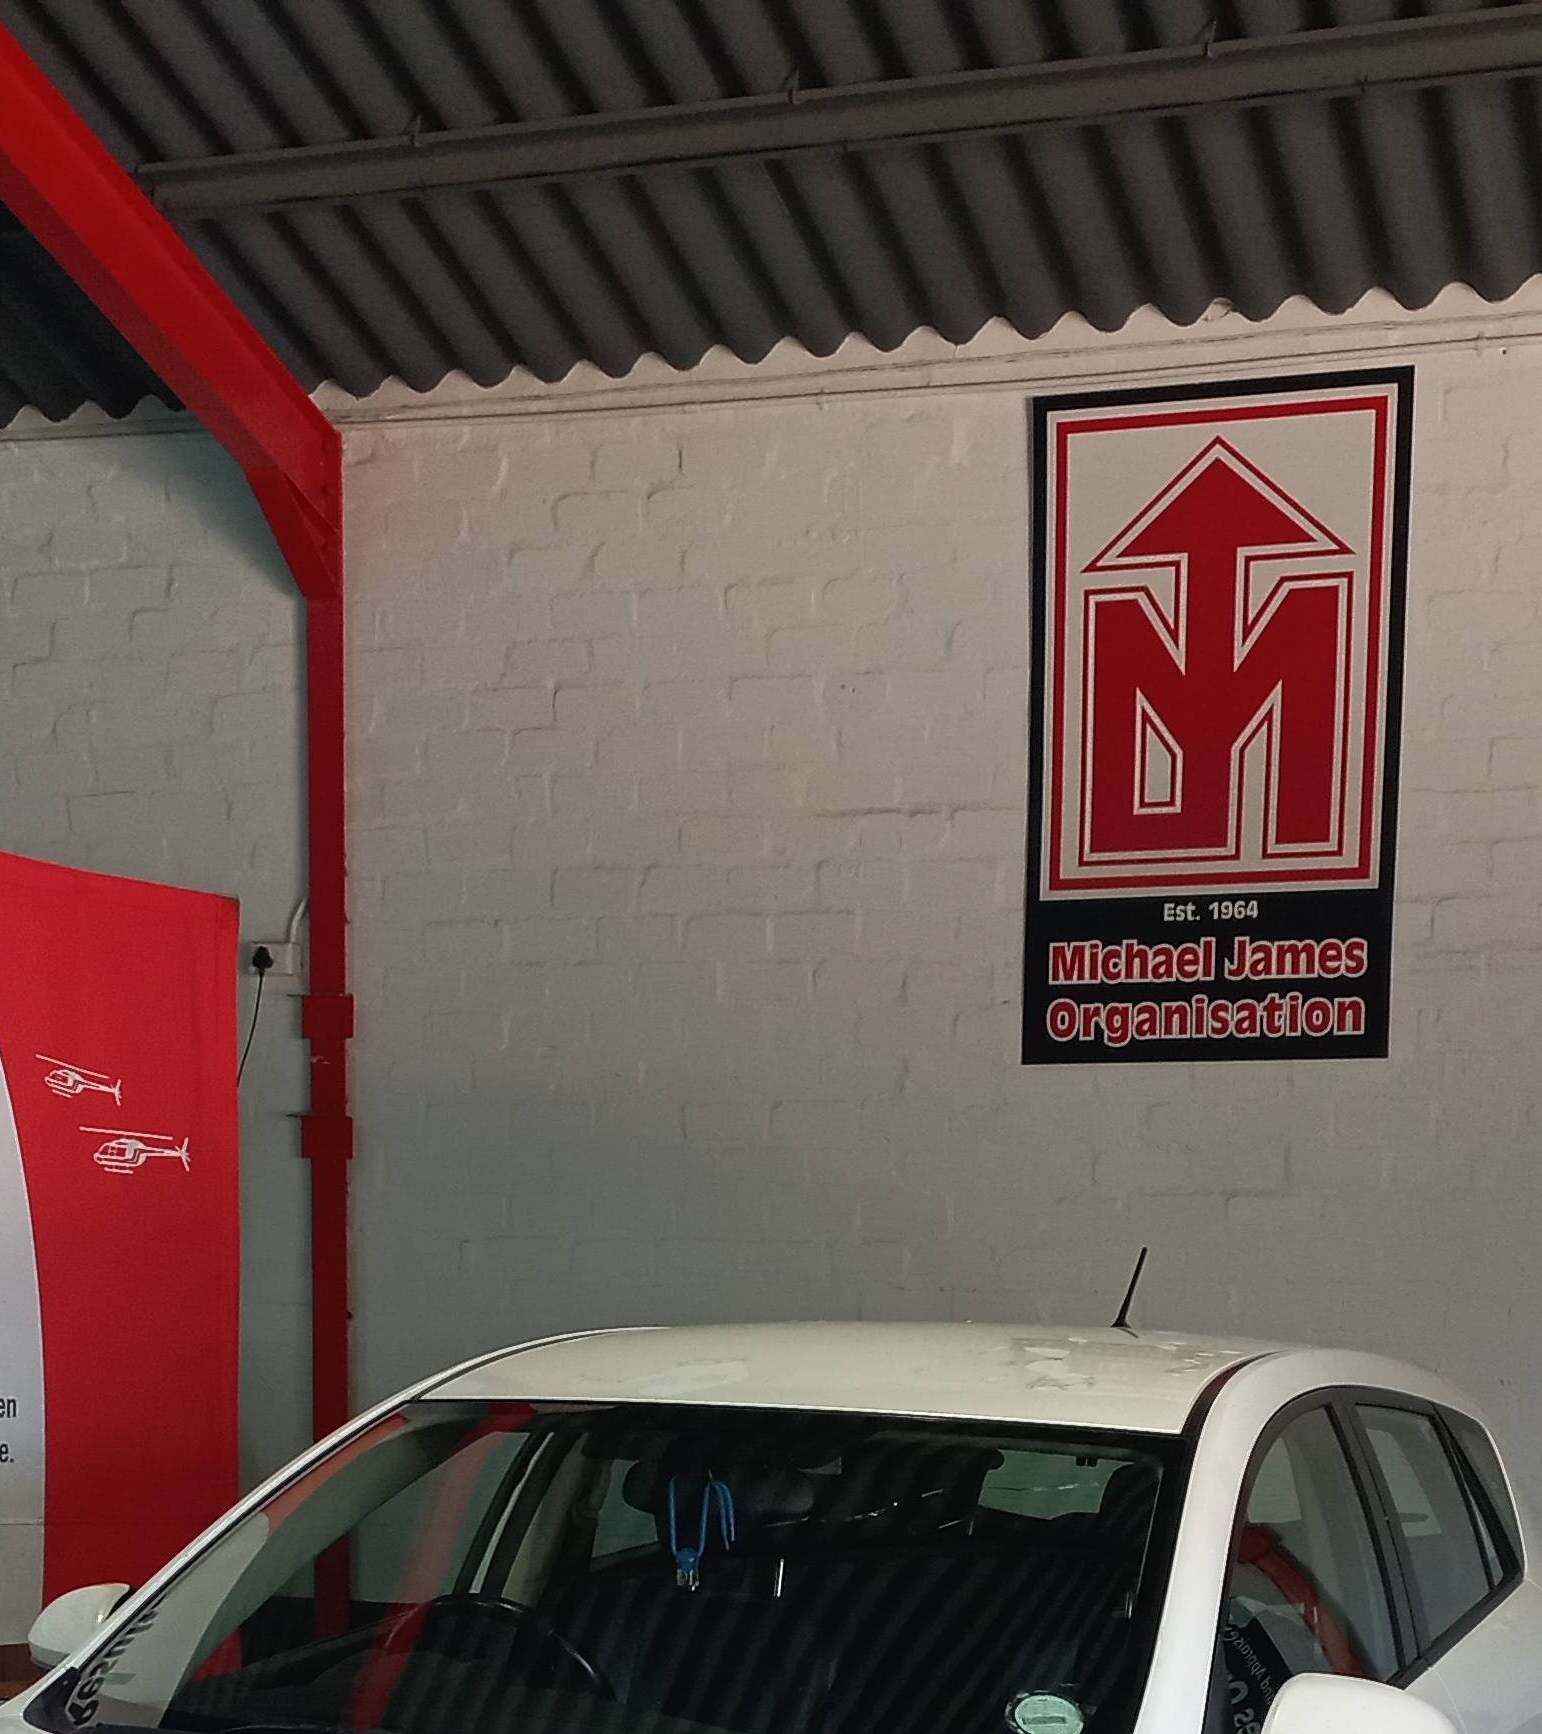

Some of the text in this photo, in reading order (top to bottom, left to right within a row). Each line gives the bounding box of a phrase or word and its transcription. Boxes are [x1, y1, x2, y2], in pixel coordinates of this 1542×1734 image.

[1164, 901, 1258, 921] Est. 1964
[1048, 936, 1367, 986] Michael James
[1046, 995, 1366, 1046] Organisation
